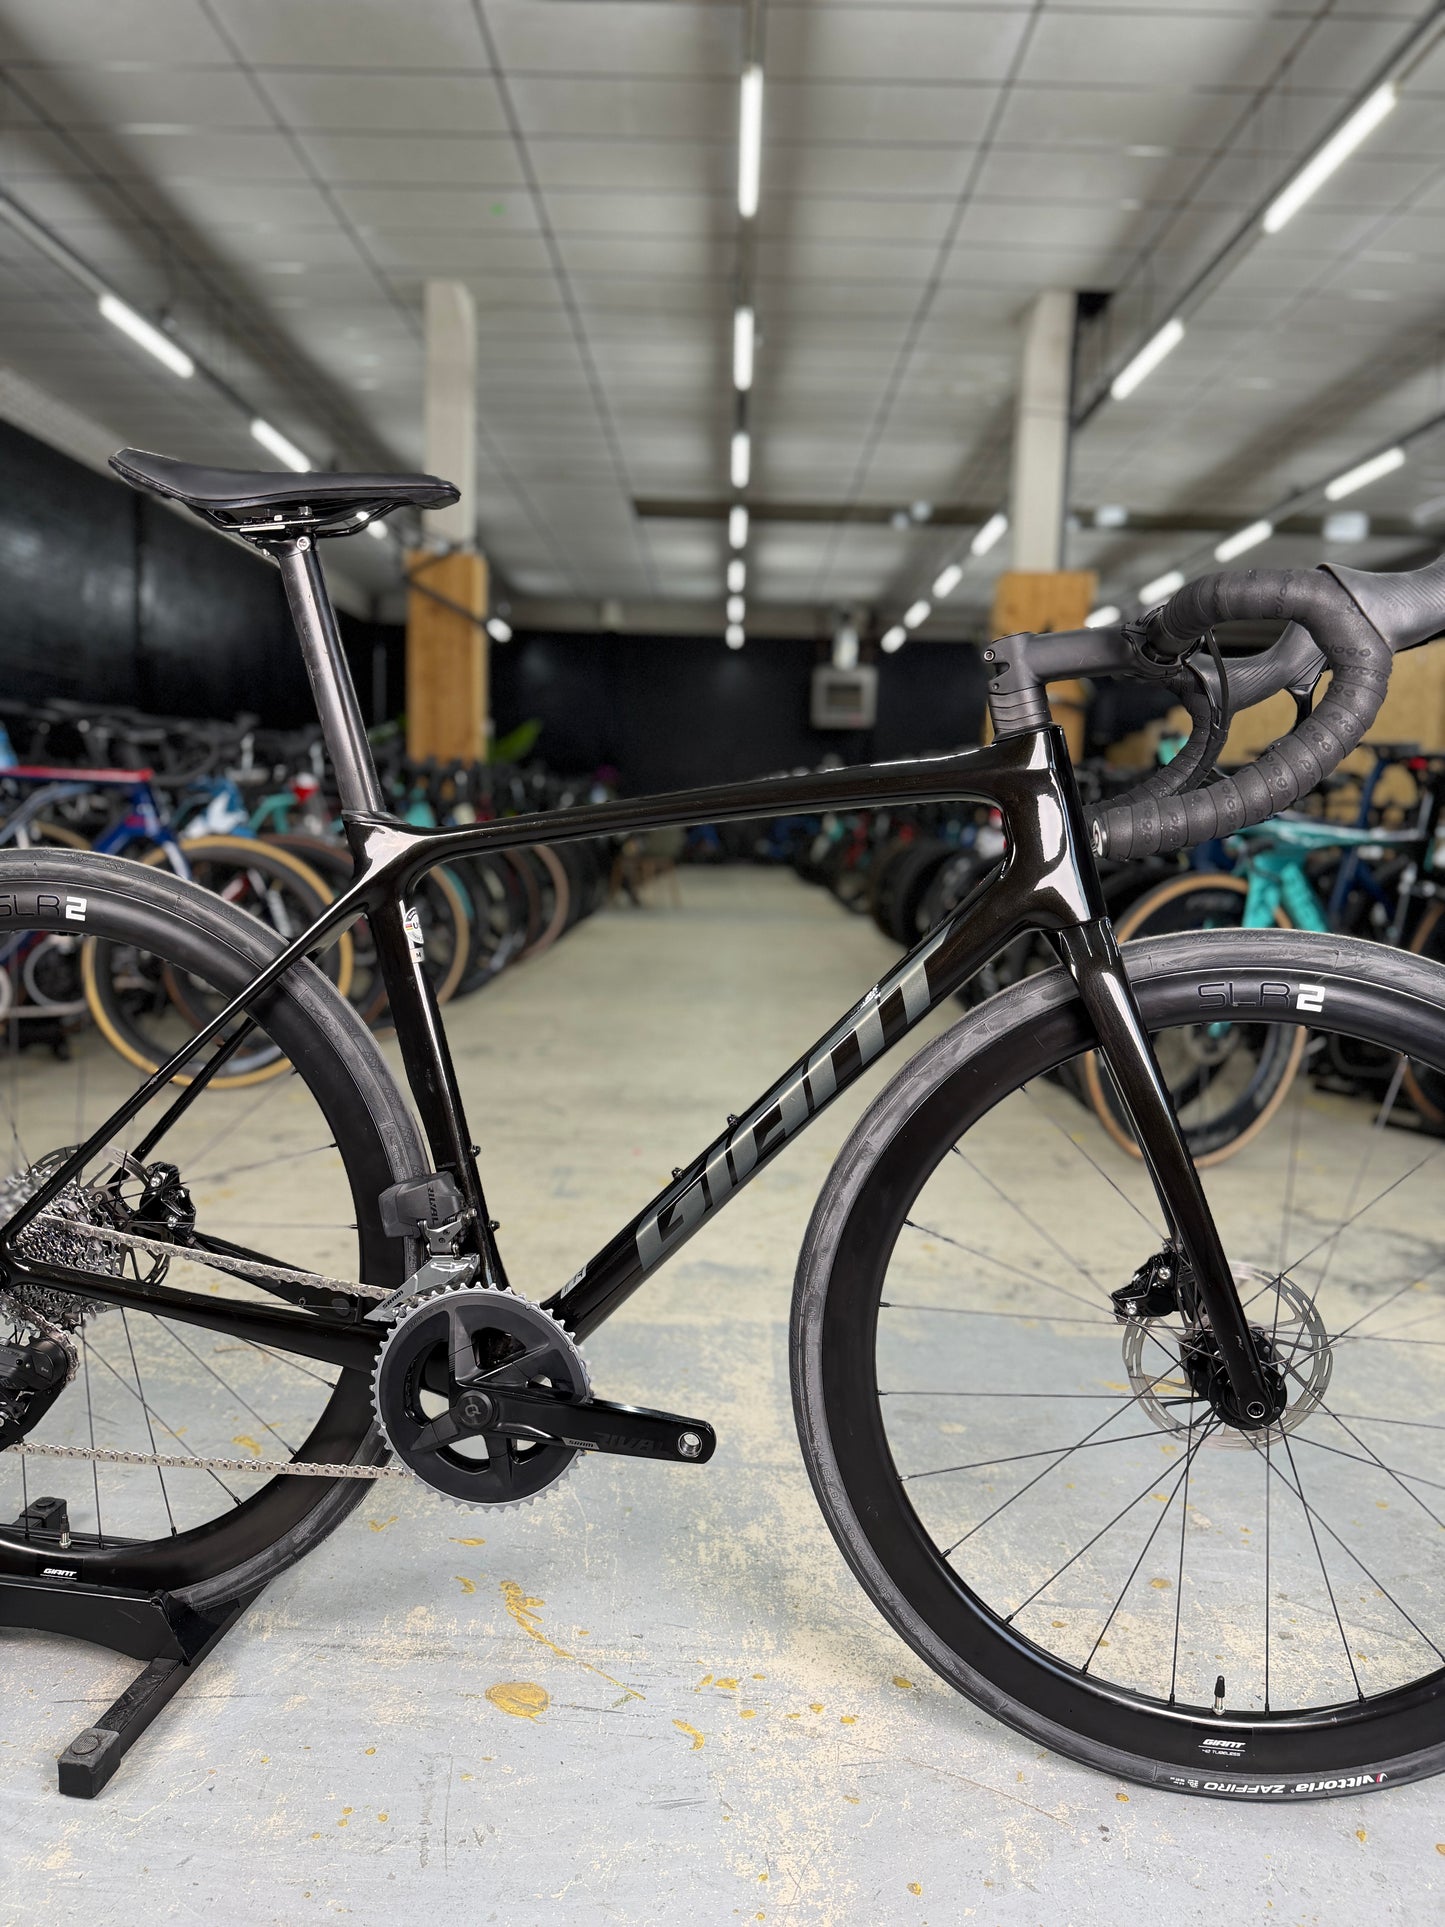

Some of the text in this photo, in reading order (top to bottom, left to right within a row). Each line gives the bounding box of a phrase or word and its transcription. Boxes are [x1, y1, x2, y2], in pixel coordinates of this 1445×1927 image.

[1198, 981, 1291, 1009] SLR
[636, 917, 956, 1272] GIANT
[43, 1567, 78, 1577] GIANT
[1202, 1738, 1246, 1749] GIANT
[1203, 1782, 1286, 1794] ZAFFIRO
